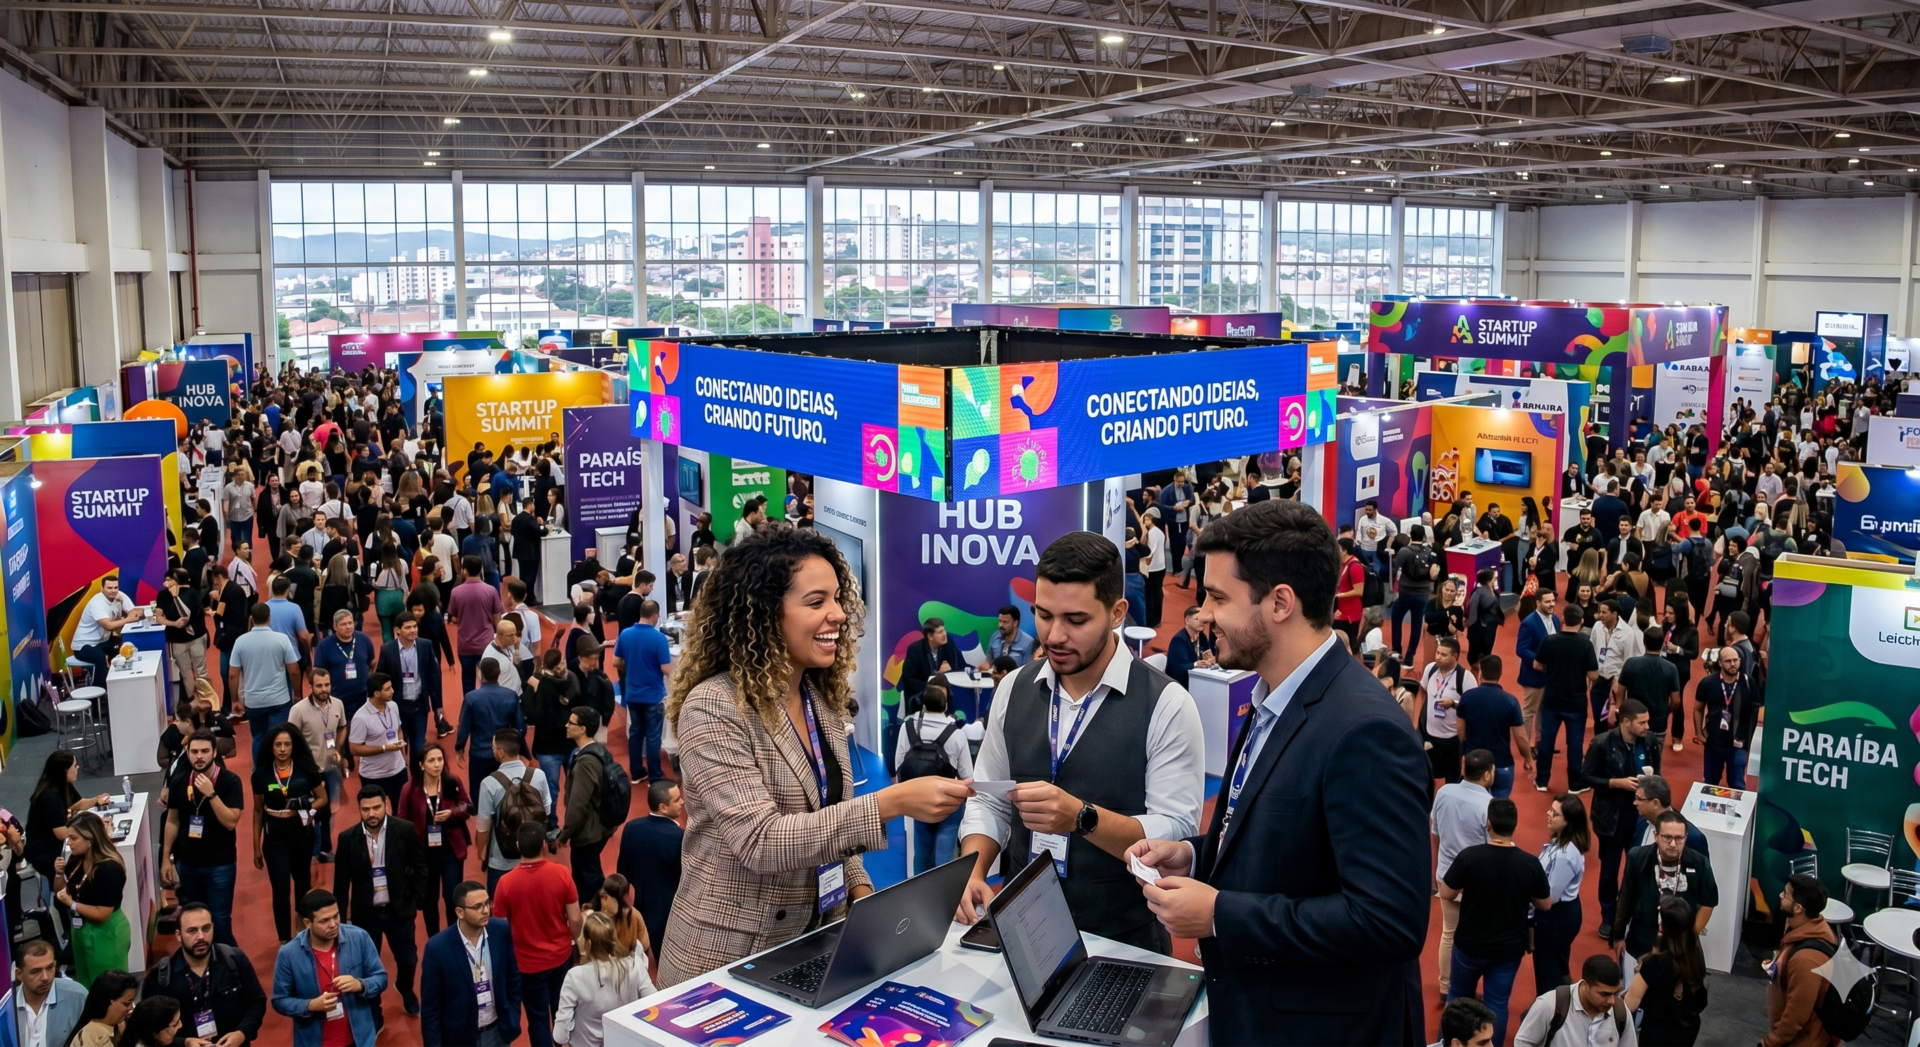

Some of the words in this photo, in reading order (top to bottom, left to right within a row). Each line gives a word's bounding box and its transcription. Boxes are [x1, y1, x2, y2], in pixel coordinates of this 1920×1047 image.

[1478, 318, 1538, 334] STARTUP
[1477, 332, 1532, 346] SUMMIT
[186, 384, 216, 395] HUB
[695, 376, 783, 408] CONECTANDO
[786, 387, 838, 421] IDEIAS,
[1086, 383, 1204, 418] CONECTANDO
[1207, 378, 1260, 402] IDEIAS,
[178, 395, 224, 408] INOVA
[476, 398, 558, 418] STARTUP
[481, 414, 553, 433] SUMMIT
[704, 403, 762, 432] CRIANDO
[764, 412, 827, 445] FUTURO.
[1101, 414, 1179, 446] CRIANDO
[1182, 406, 1248, 435] FUTURO.
[579, 470, 625, 488] TECH
[71, 488, 149, 505] STARTUP
[73, 502, 143, 519] SUMMIT
[939, 498, 1023, 530] HUB
[921, 533, 1041, 566] INOVA
[1782, 727, 1899, 768] PARAÍBA
[1781, 756, 1849, 790] TECH
